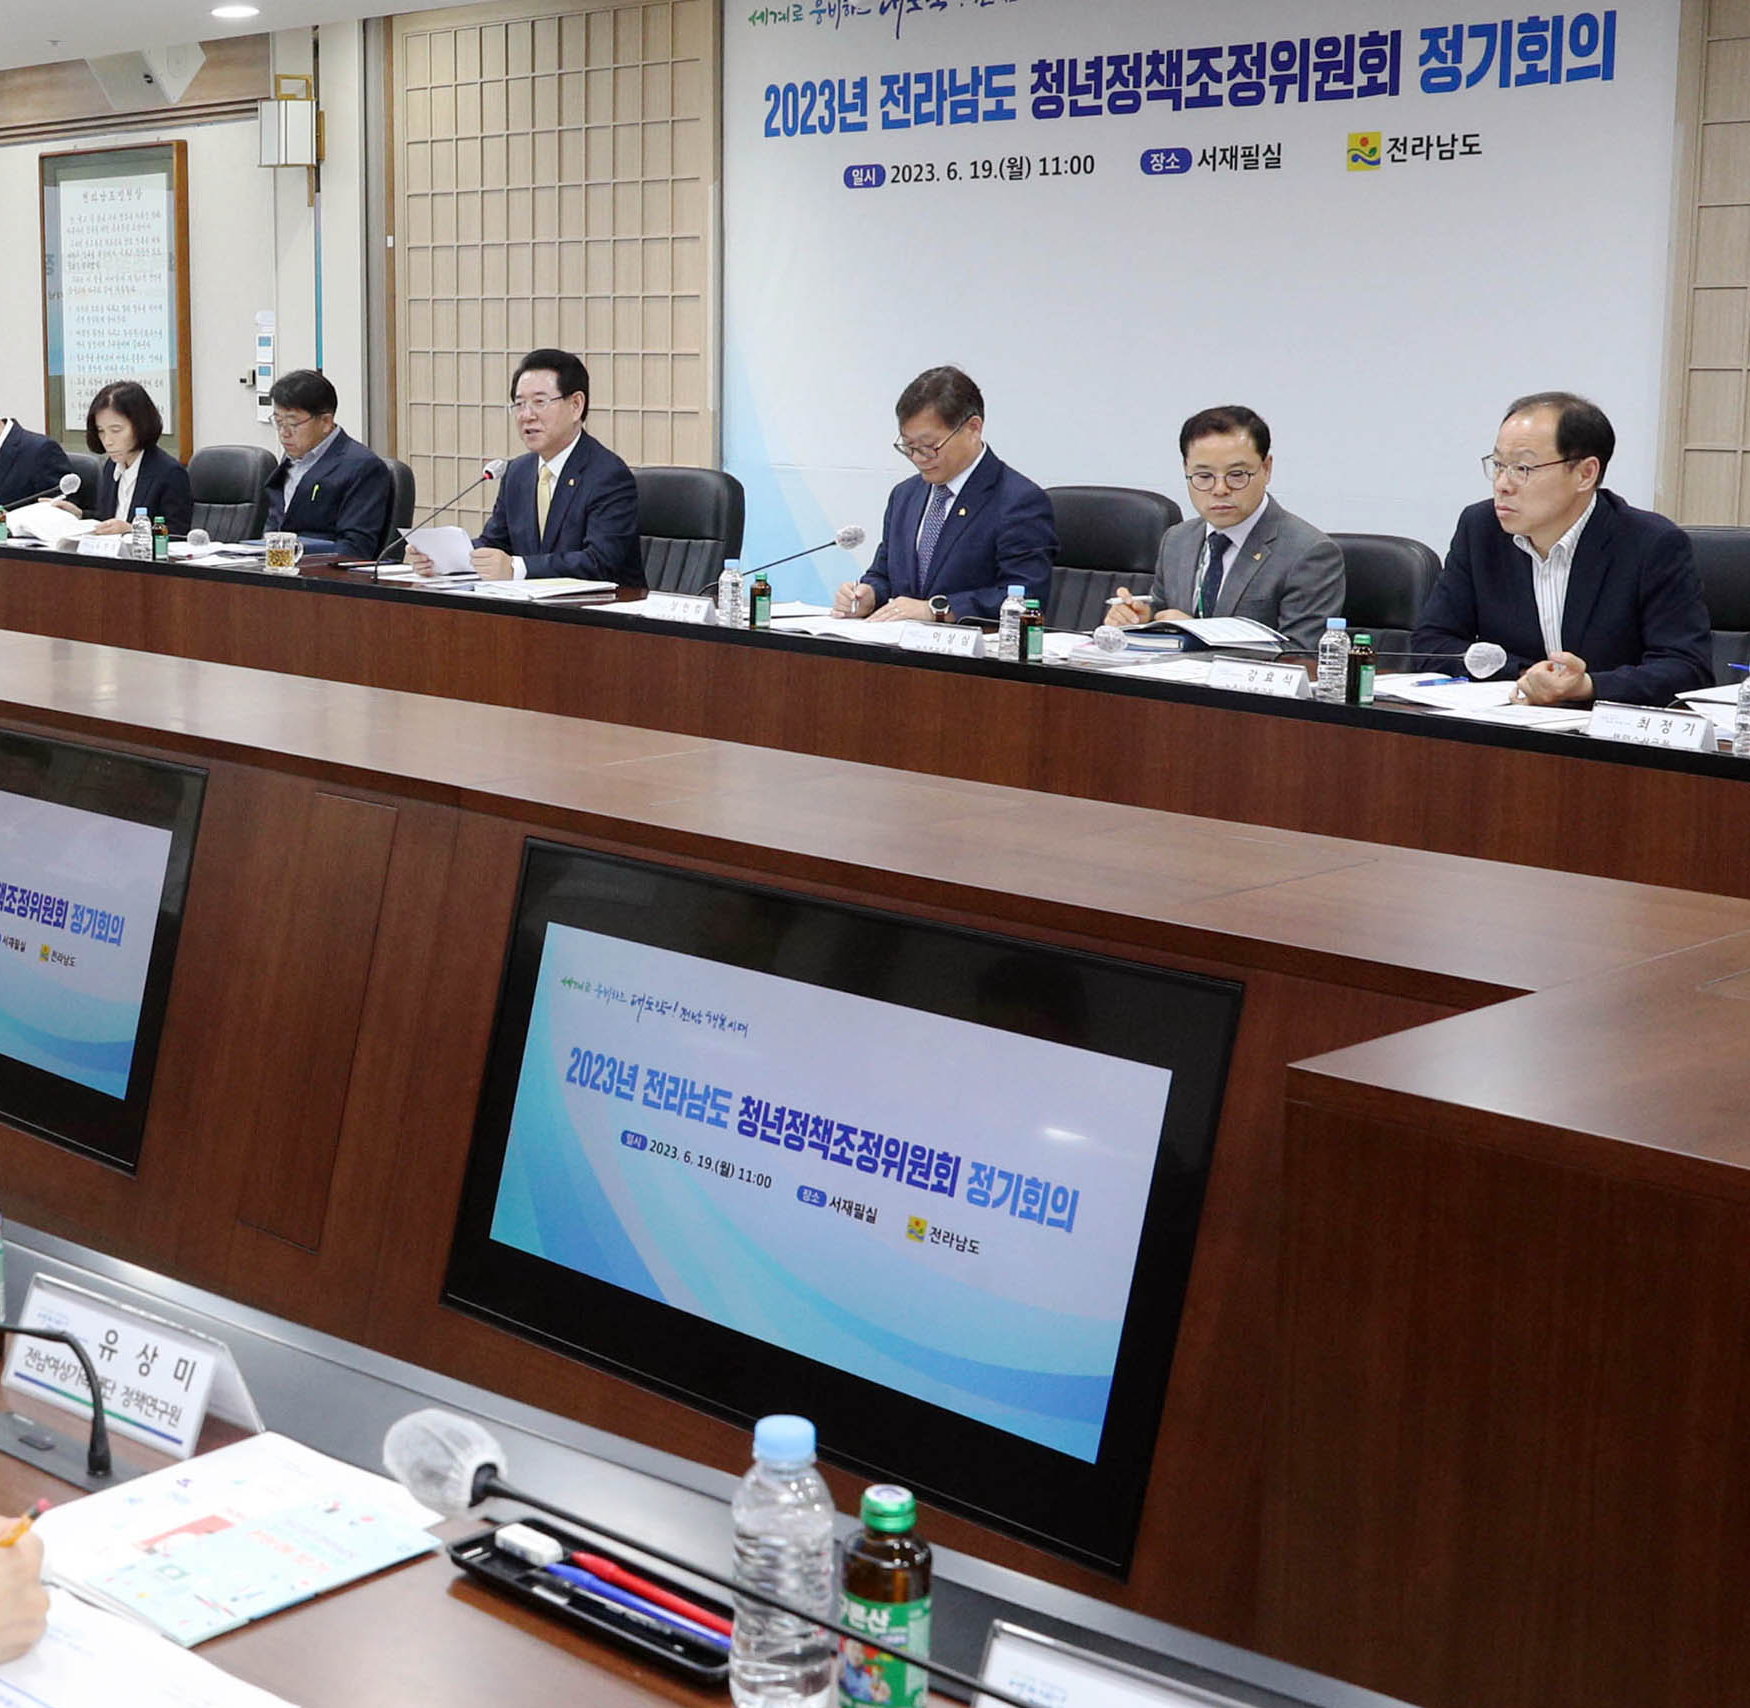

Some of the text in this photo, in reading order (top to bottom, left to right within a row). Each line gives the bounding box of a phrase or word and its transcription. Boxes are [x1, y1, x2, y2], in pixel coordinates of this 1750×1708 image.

[764, 10, 1616, 138] 2023년 전라남도 청년정책조정위원회 정기회의
[851, 168, 877, 186] 일시
[890, 163, 939, 184] 2023.
[947, 162, 963, 182] 6.
[1039, 155, 1095, 177] 11:00
[1149, 152, 1181, 171] 장소
[1197, 142, 1282, 173] 서재필실
[1386, 132, 1483, 163] 전라남도
[70, 904, 125, 947] 정기회의
[565, 1046, 1080, 1234] 2023년 전라남도 청년정책조정위원회 정기회의
[738, 1166, 773, 1189] 11:00
[828, 1195, 878, 1225] 서재필실
[928, 1225, 981, 1256] 전라남도
[121, 1385, 184, 1430] 정책연구원
